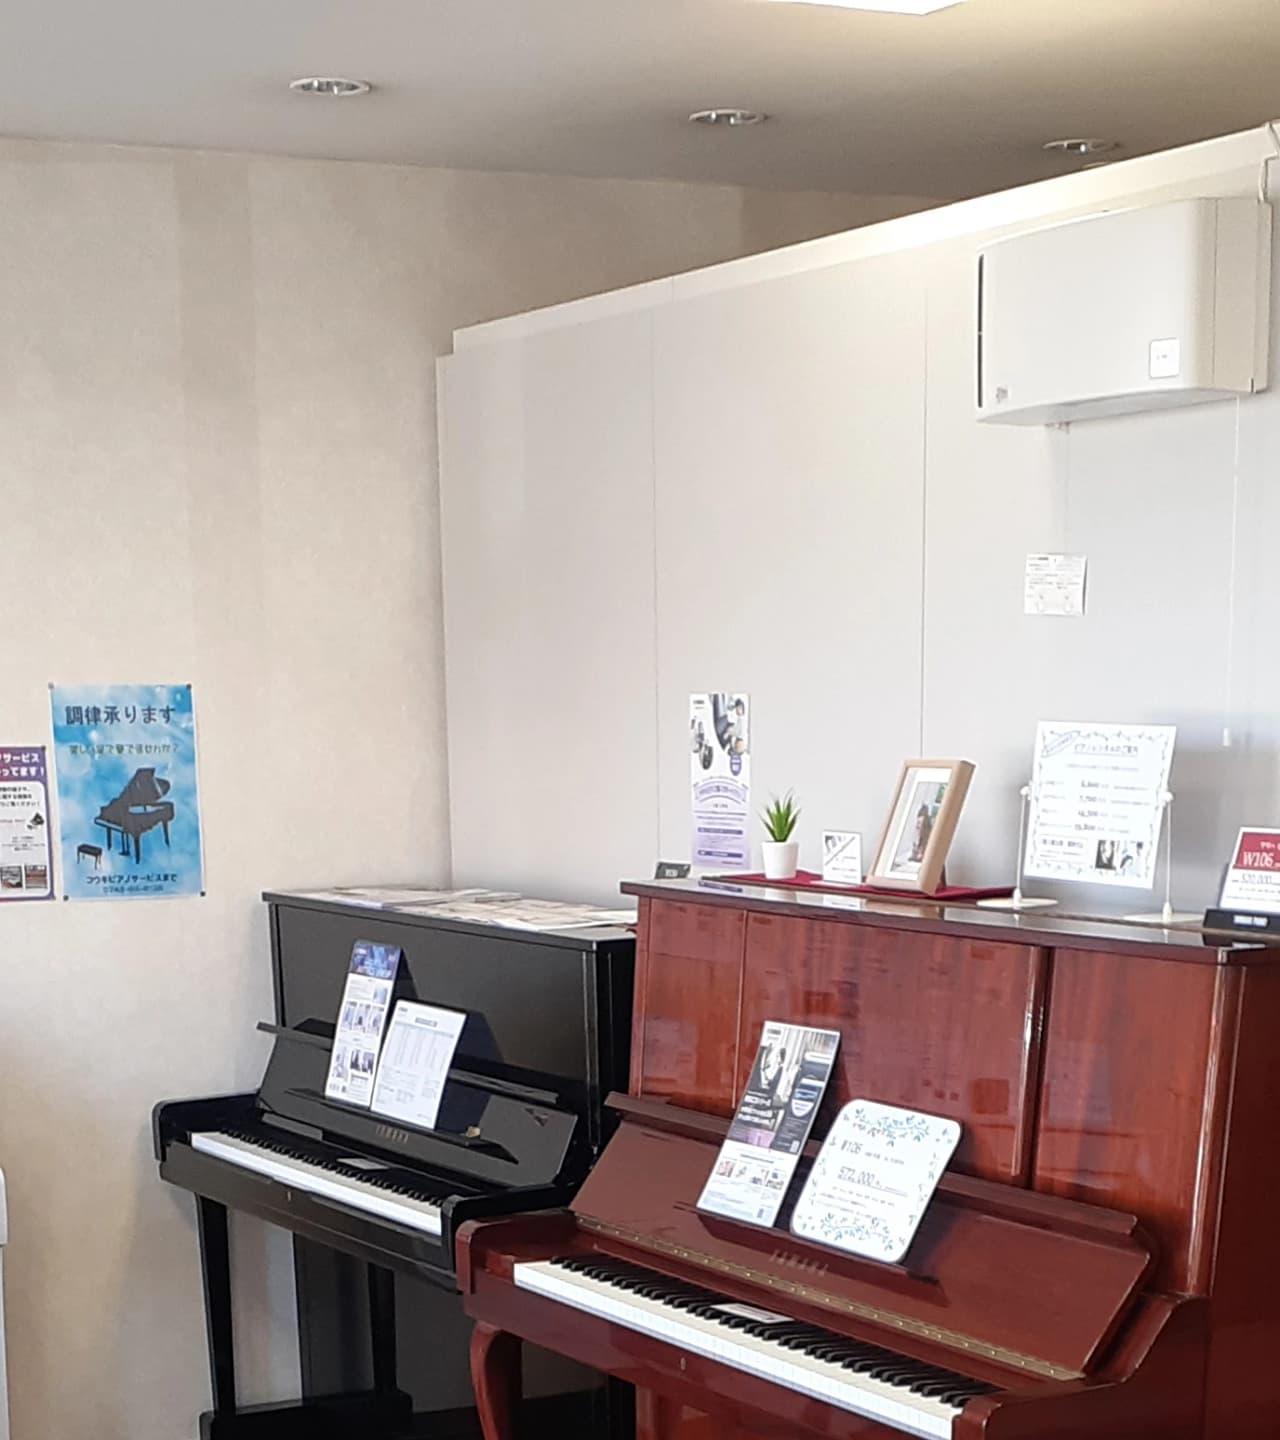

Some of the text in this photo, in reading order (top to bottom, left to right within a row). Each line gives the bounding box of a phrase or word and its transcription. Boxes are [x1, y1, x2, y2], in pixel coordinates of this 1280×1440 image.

[65, 705, 176, 725] 調律承ります
[1242, 850, 1274, 868] W106
